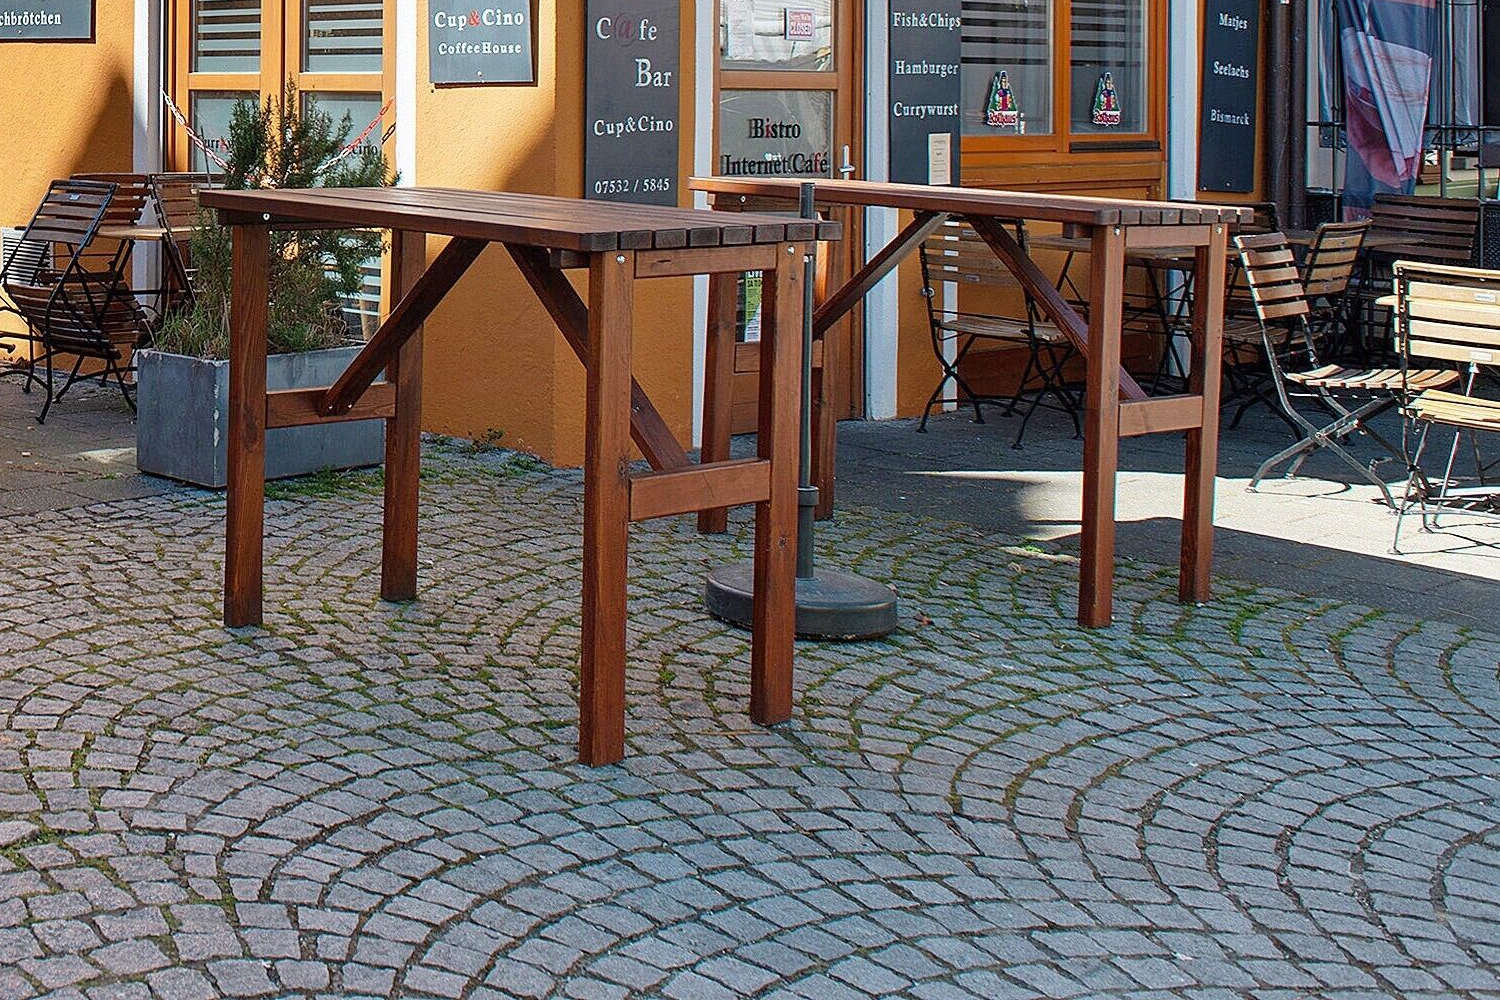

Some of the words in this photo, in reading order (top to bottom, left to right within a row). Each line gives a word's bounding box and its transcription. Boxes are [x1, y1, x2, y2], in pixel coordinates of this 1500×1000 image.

[434, 8, 524, 31] Cup&Cino
[893, 12, 961, 31] Fish&Chips
[1218, 12, 1248, 31] Matjes
[635, 58, 672, 87] Bar
[895, 60, 959, 78] Hamburger
[1213, 61, 1250, 79] Seelachs
[893, 102, 959, 119] Currywurst
[1210, 109, 1250, 126] Bismarck
[593, 115, 674, 138] Cup&Cino
[751, 118, 801, 139] Bistro
[594, 179, 629, 194] 07532
[633, 179, 639, 192] /
[643, 178, 670, 192] 5845
